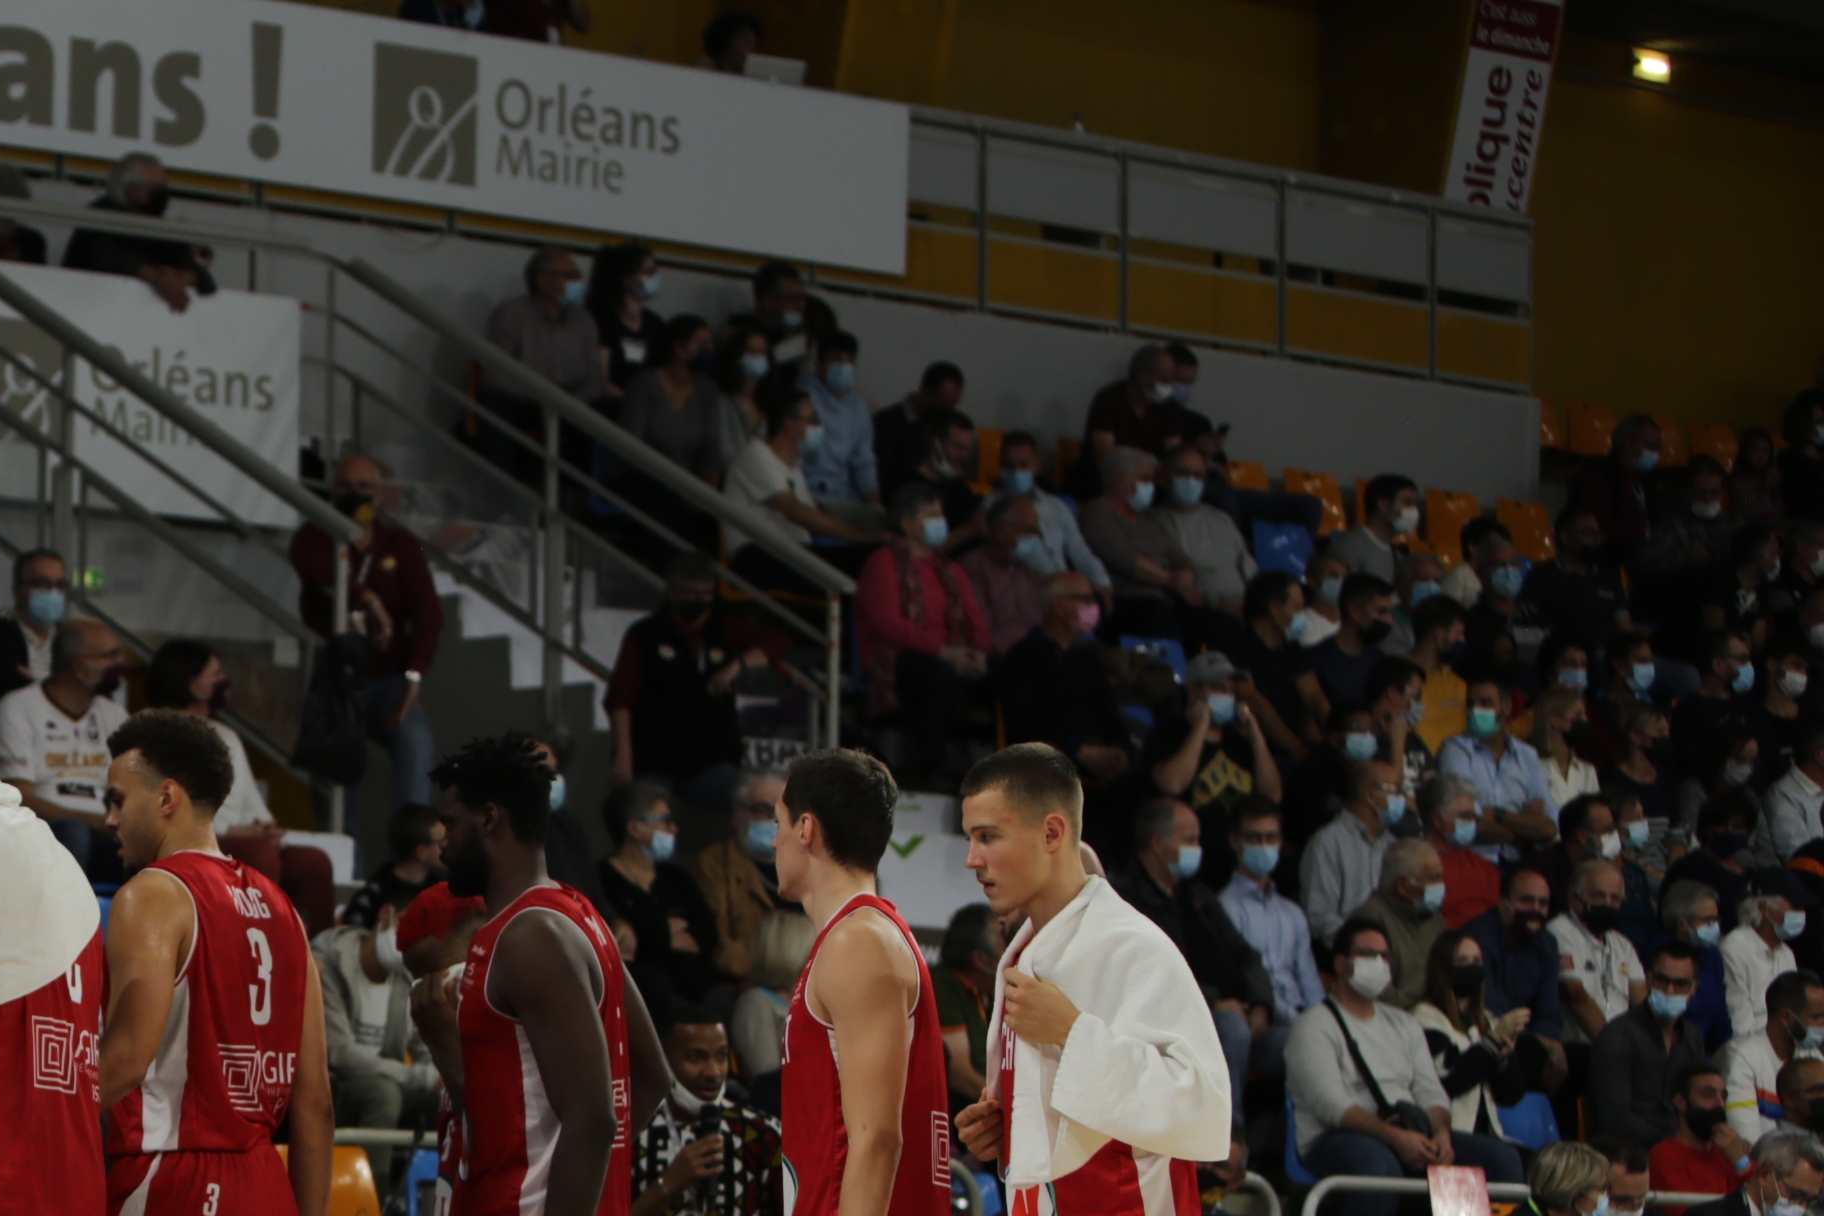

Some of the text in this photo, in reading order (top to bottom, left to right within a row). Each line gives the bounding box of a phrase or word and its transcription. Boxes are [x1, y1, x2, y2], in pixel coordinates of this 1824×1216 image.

[495, 78, 681, 155] Orléans
[495, 133, 624, 195] Mairie
[246, 927, 272, 1026] 3
